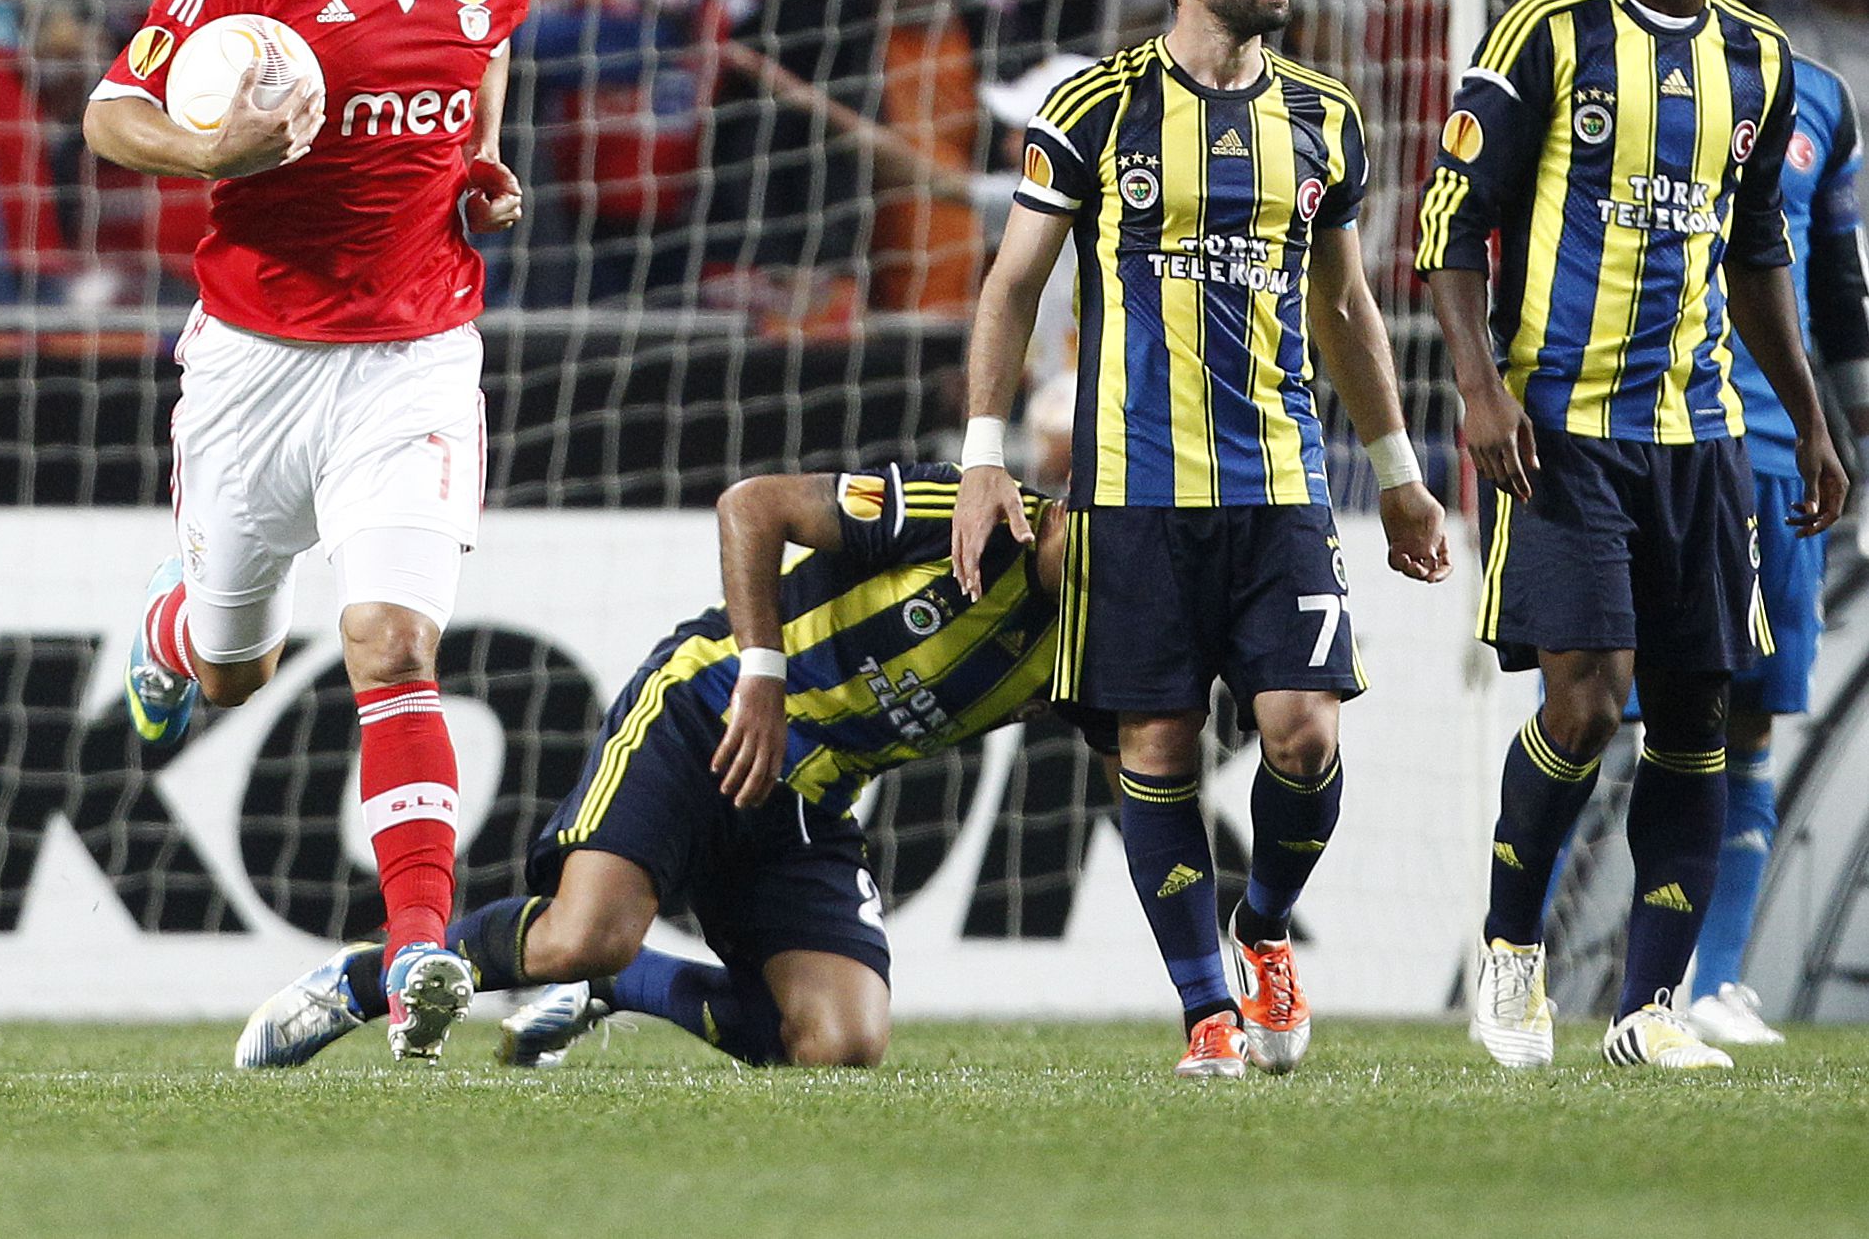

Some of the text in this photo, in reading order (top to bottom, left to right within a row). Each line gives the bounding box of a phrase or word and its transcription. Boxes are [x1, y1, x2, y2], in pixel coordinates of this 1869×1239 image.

[341, 88, 471, 136] meo
[1629, 174, 1708, 207] TÜRK
[1147, 253, 1290, 295] TELEKOM
[1297, 593, 1348, 667] 7
